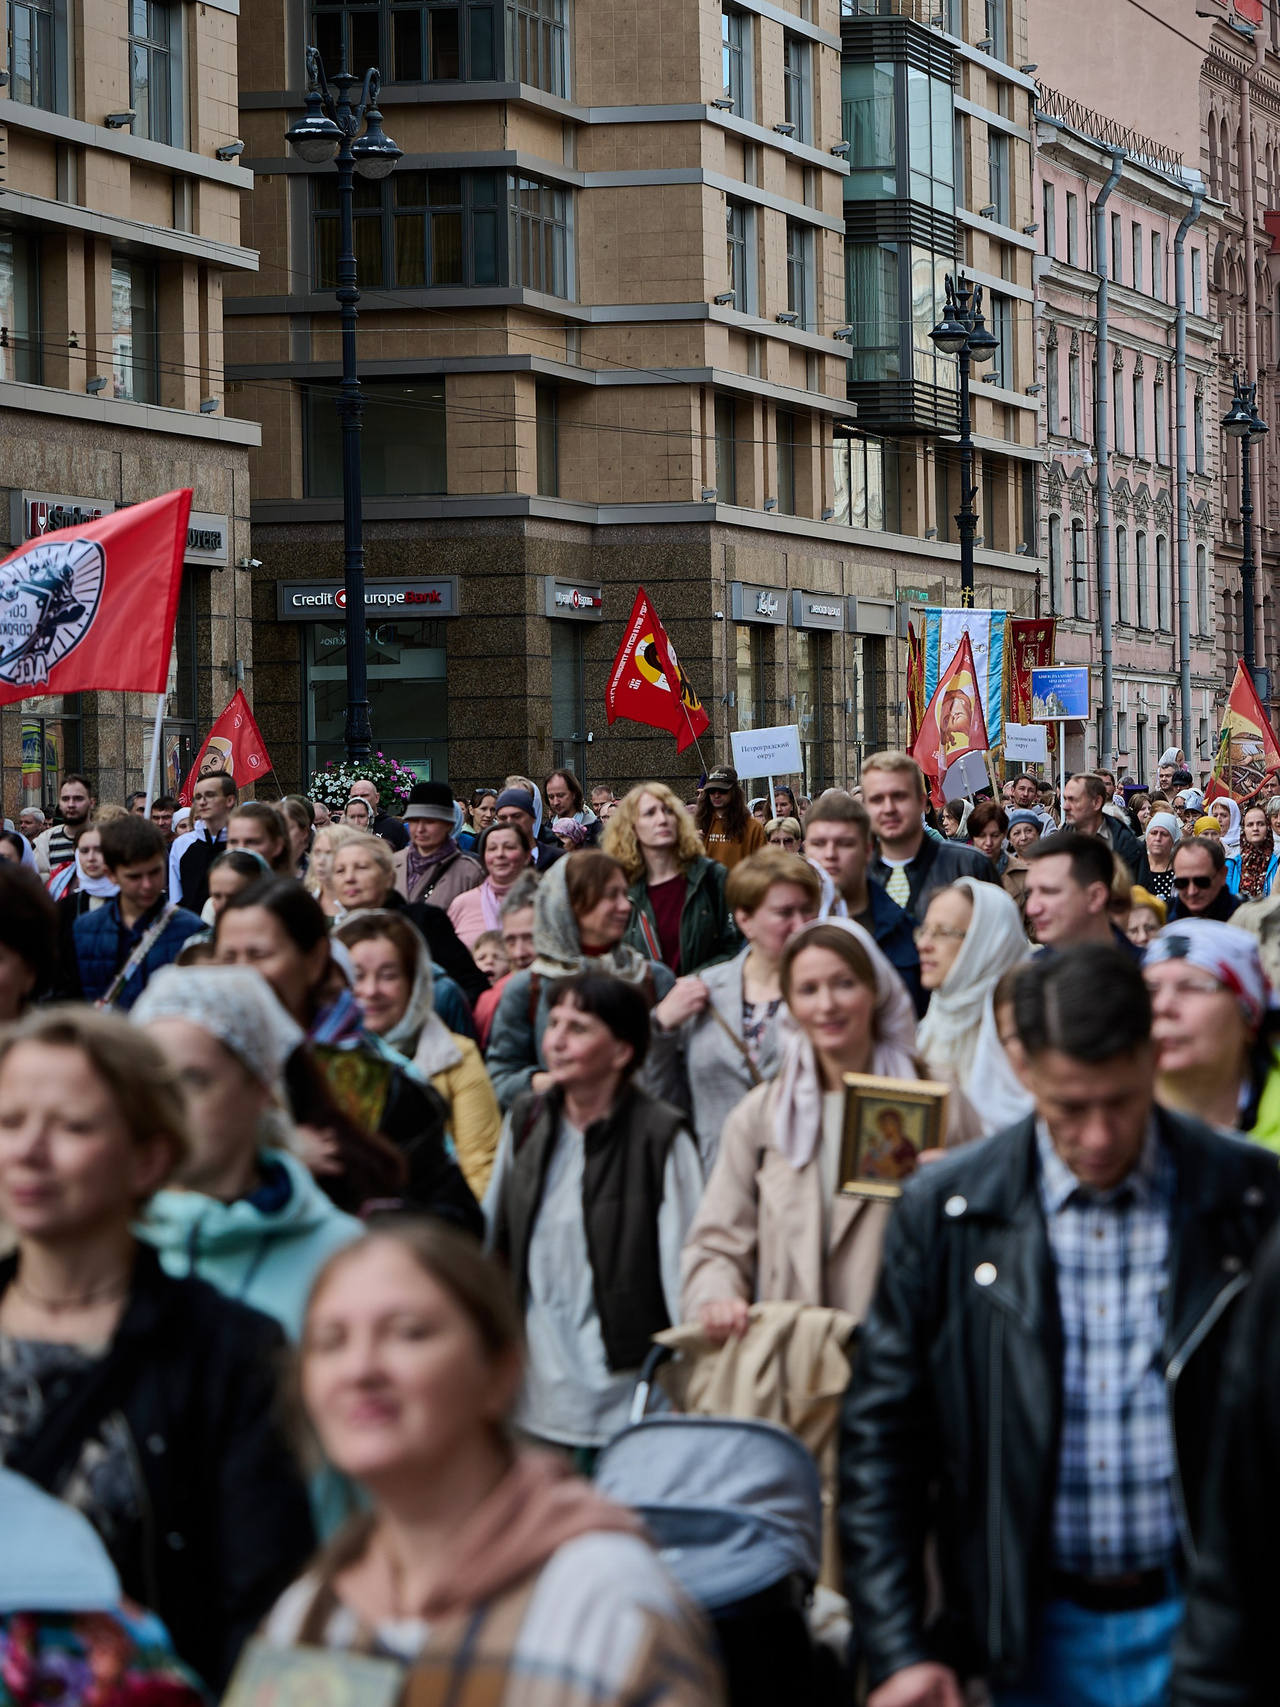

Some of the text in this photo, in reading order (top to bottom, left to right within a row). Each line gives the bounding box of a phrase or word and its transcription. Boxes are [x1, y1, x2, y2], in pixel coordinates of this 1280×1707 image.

[292, 589, 442, 609] Credit uropeBank
[741, 741, 790, 752] Петроградский
